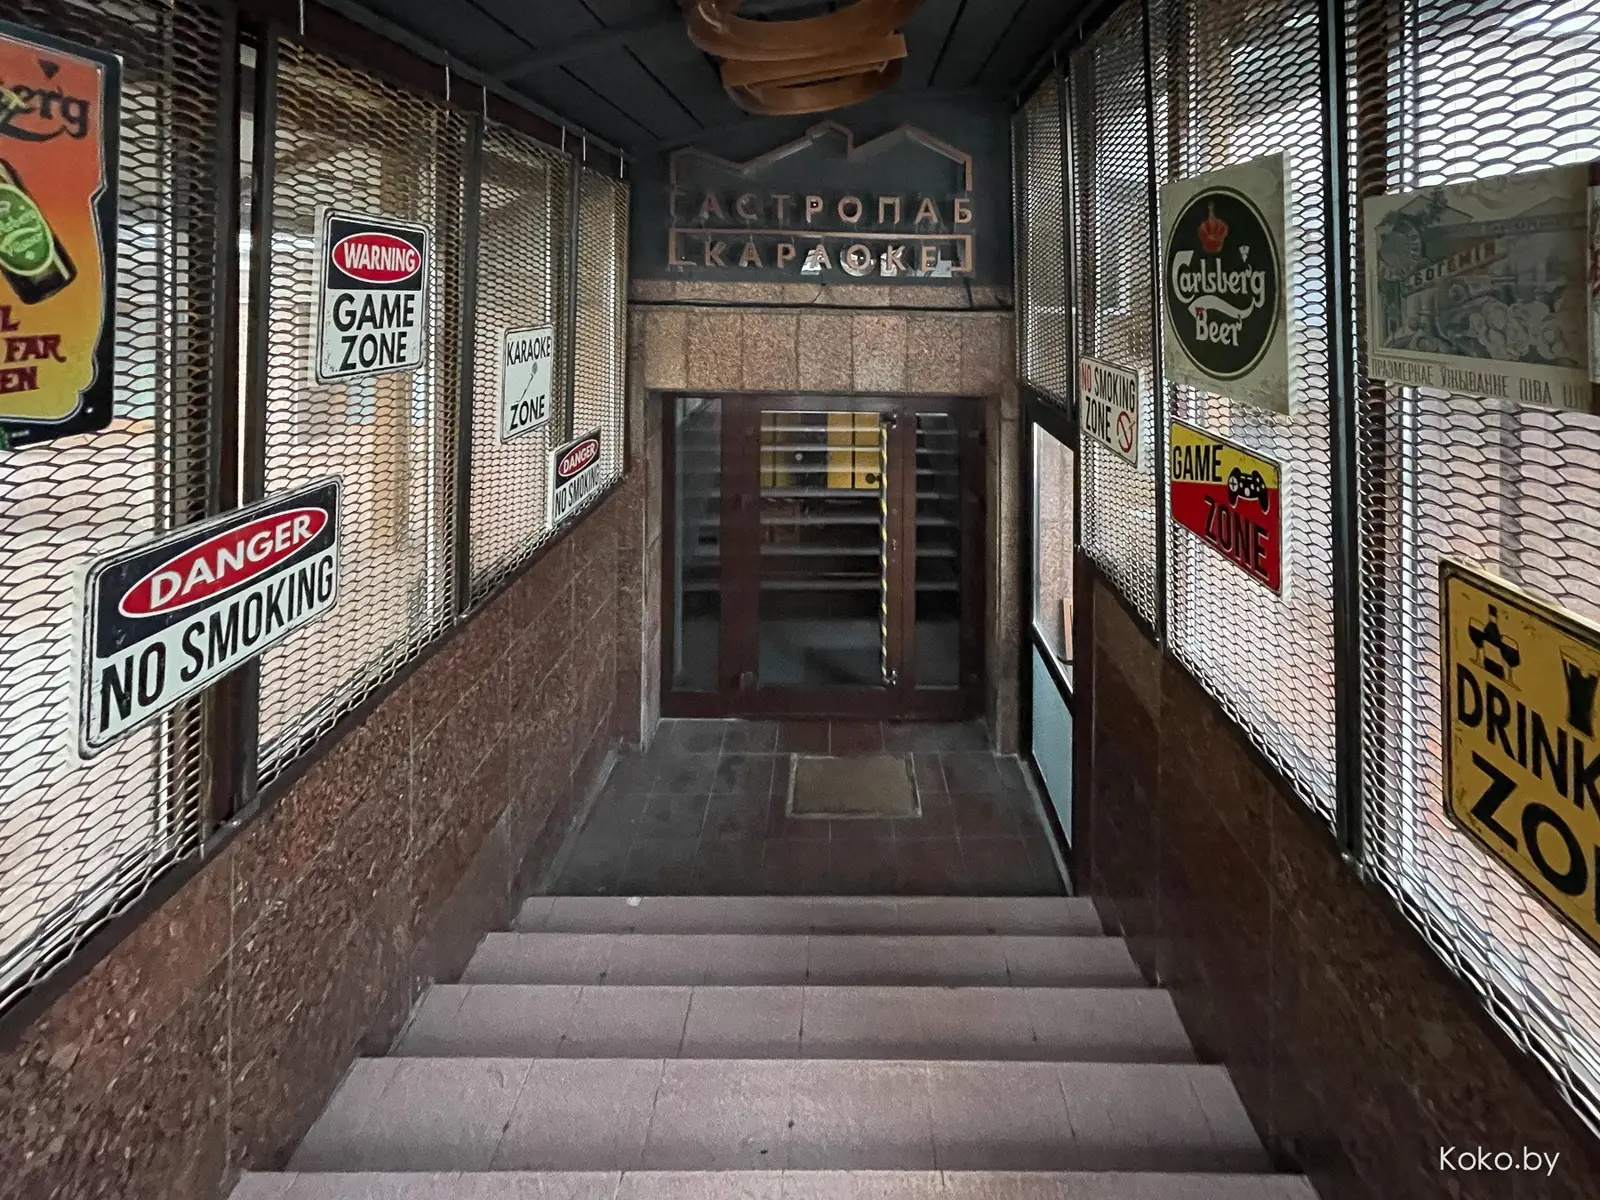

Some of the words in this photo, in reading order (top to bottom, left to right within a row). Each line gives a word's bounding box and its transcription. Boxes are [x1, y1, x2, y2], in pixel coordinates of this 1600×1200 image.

[343, 241, 416, 273] WARNING
[704, 241, 939, 273] КАРАОКЕ
[1172, 248, 1266, 310] Carlsberg
[333, 293, 416, 332] GAME
[1195, 308, 1243, 346] Beer
[4, 334, 67, 363] FAR
[339, 332, 408, 372] ZONE
[506, 336, 551, 367] KARAOKE
[1081, 363, 1092, 393] NO
[1094, 367, 1135, 413] SMOKING
[509, 395, 545, 431] ZONE
[1085, 395, 1112, 444] ZONE
[563, 443, 595, 474] DANGER
[1173, 445, 1224, 482] GAME
[555, 487, 567, 518] NO
[568, 463, 600, 507] SMOKING
[1204, 494, 1270, 581] ZONE
[150, 514, 313, 610] DANGER
[100, 641, 167, 733] NO
[180, 554, 334, 683] SMOKING
[1470, 751, 1600, 924] ZO
